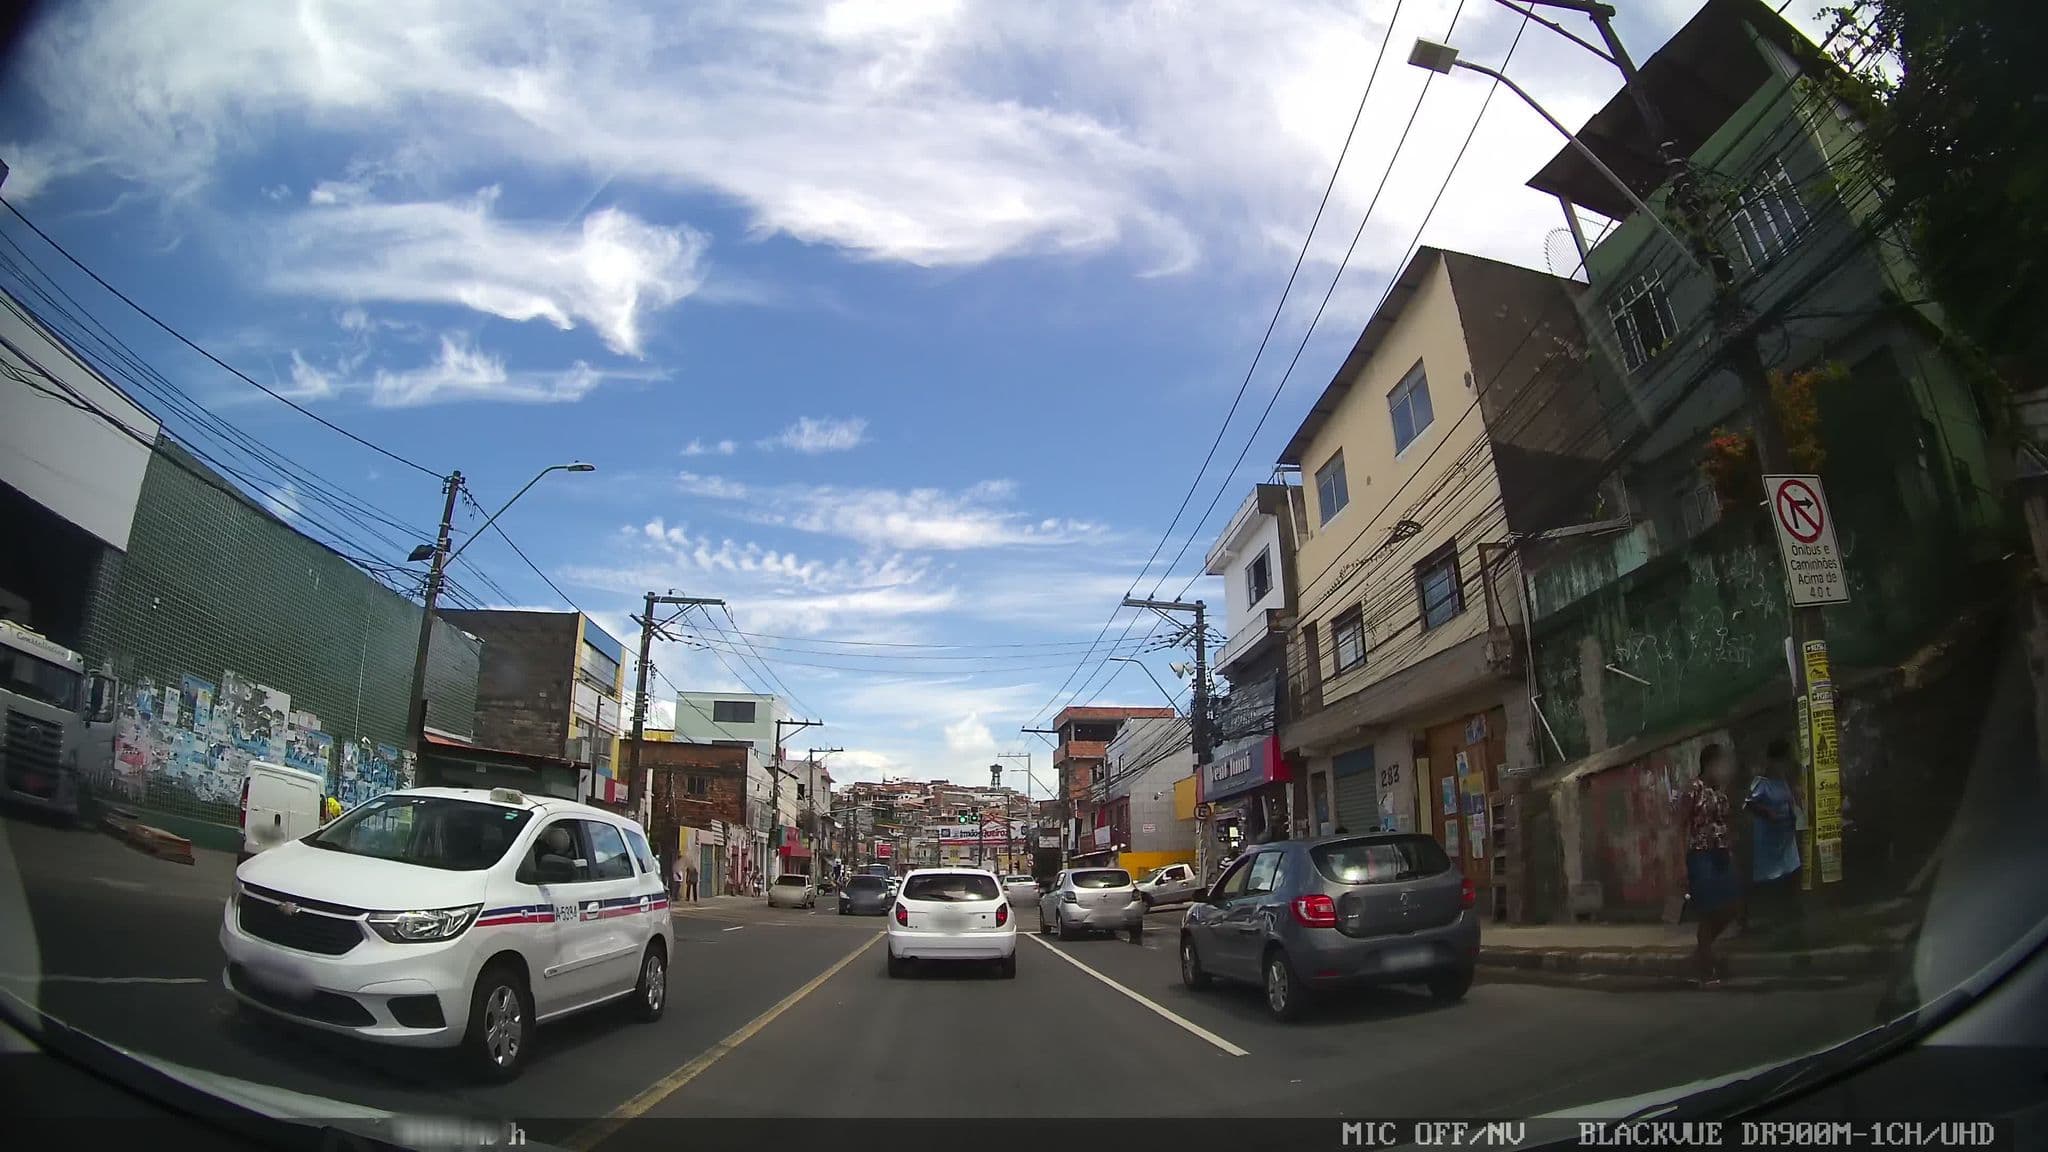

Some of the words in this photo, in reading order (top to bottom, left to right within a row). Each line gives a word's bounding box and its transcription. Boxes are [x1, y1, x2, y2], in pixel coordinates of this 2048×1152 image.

[1791, 542, 1821, 556] Ônibus
[1824, 545, 1831, 555] e
[1790, 557, 1838, 571] Caminhões
[1798, 573, 1824, 585] Acima
[1826, 572, 1837, 583] de
[1381, 763, 1400, 788] 283
